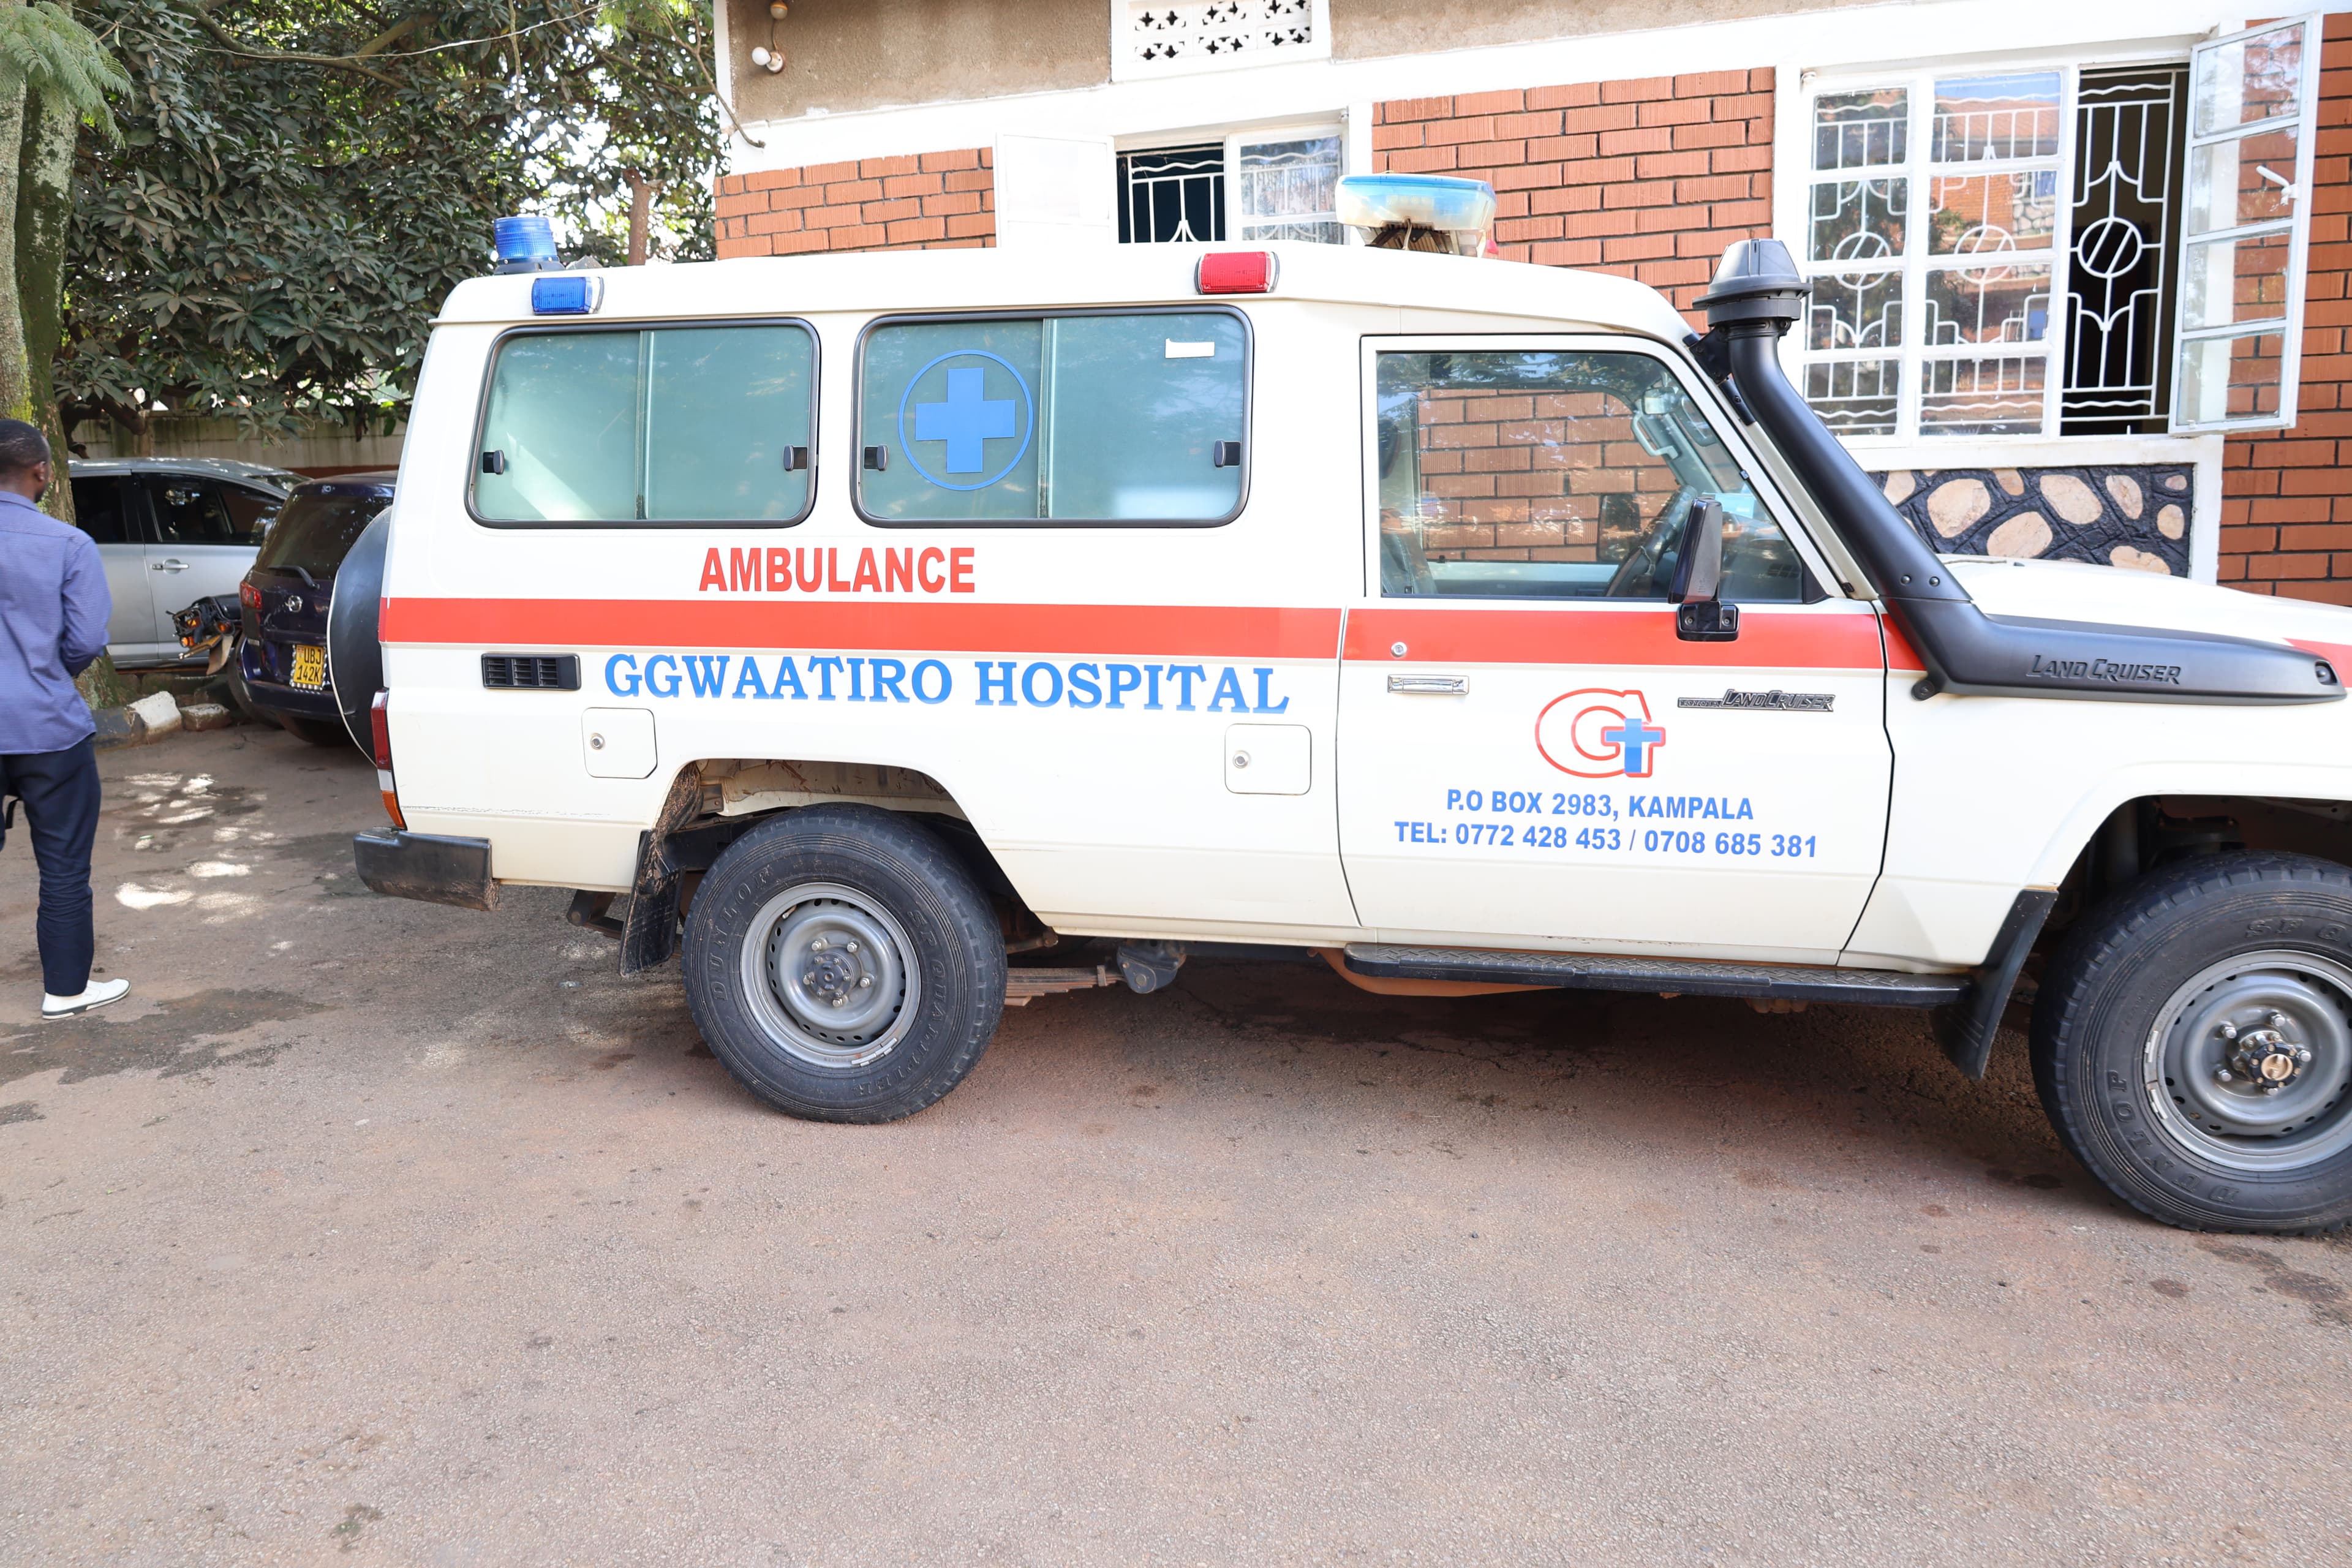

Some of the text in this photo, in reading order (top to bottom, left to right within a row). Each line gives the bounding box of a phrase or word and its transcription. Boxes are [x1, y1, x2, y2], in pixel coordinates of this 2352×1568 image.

[699, 547, 974, 593] AMBULANCE
[304, 647, 322, 665] UBJ
[2026, 655, 2181, 685] LAND CRUISER
[296, 665, 321, 682] 142K
[605, 653, 1290, 714] GGWAATIRO HOSPITAL
[1447, 789, 1754, 821] P.O BOX 2983, KAMPALA
[1395, 821, 1816, 858] TEL: 0772 428 453 / 0708 685 381
